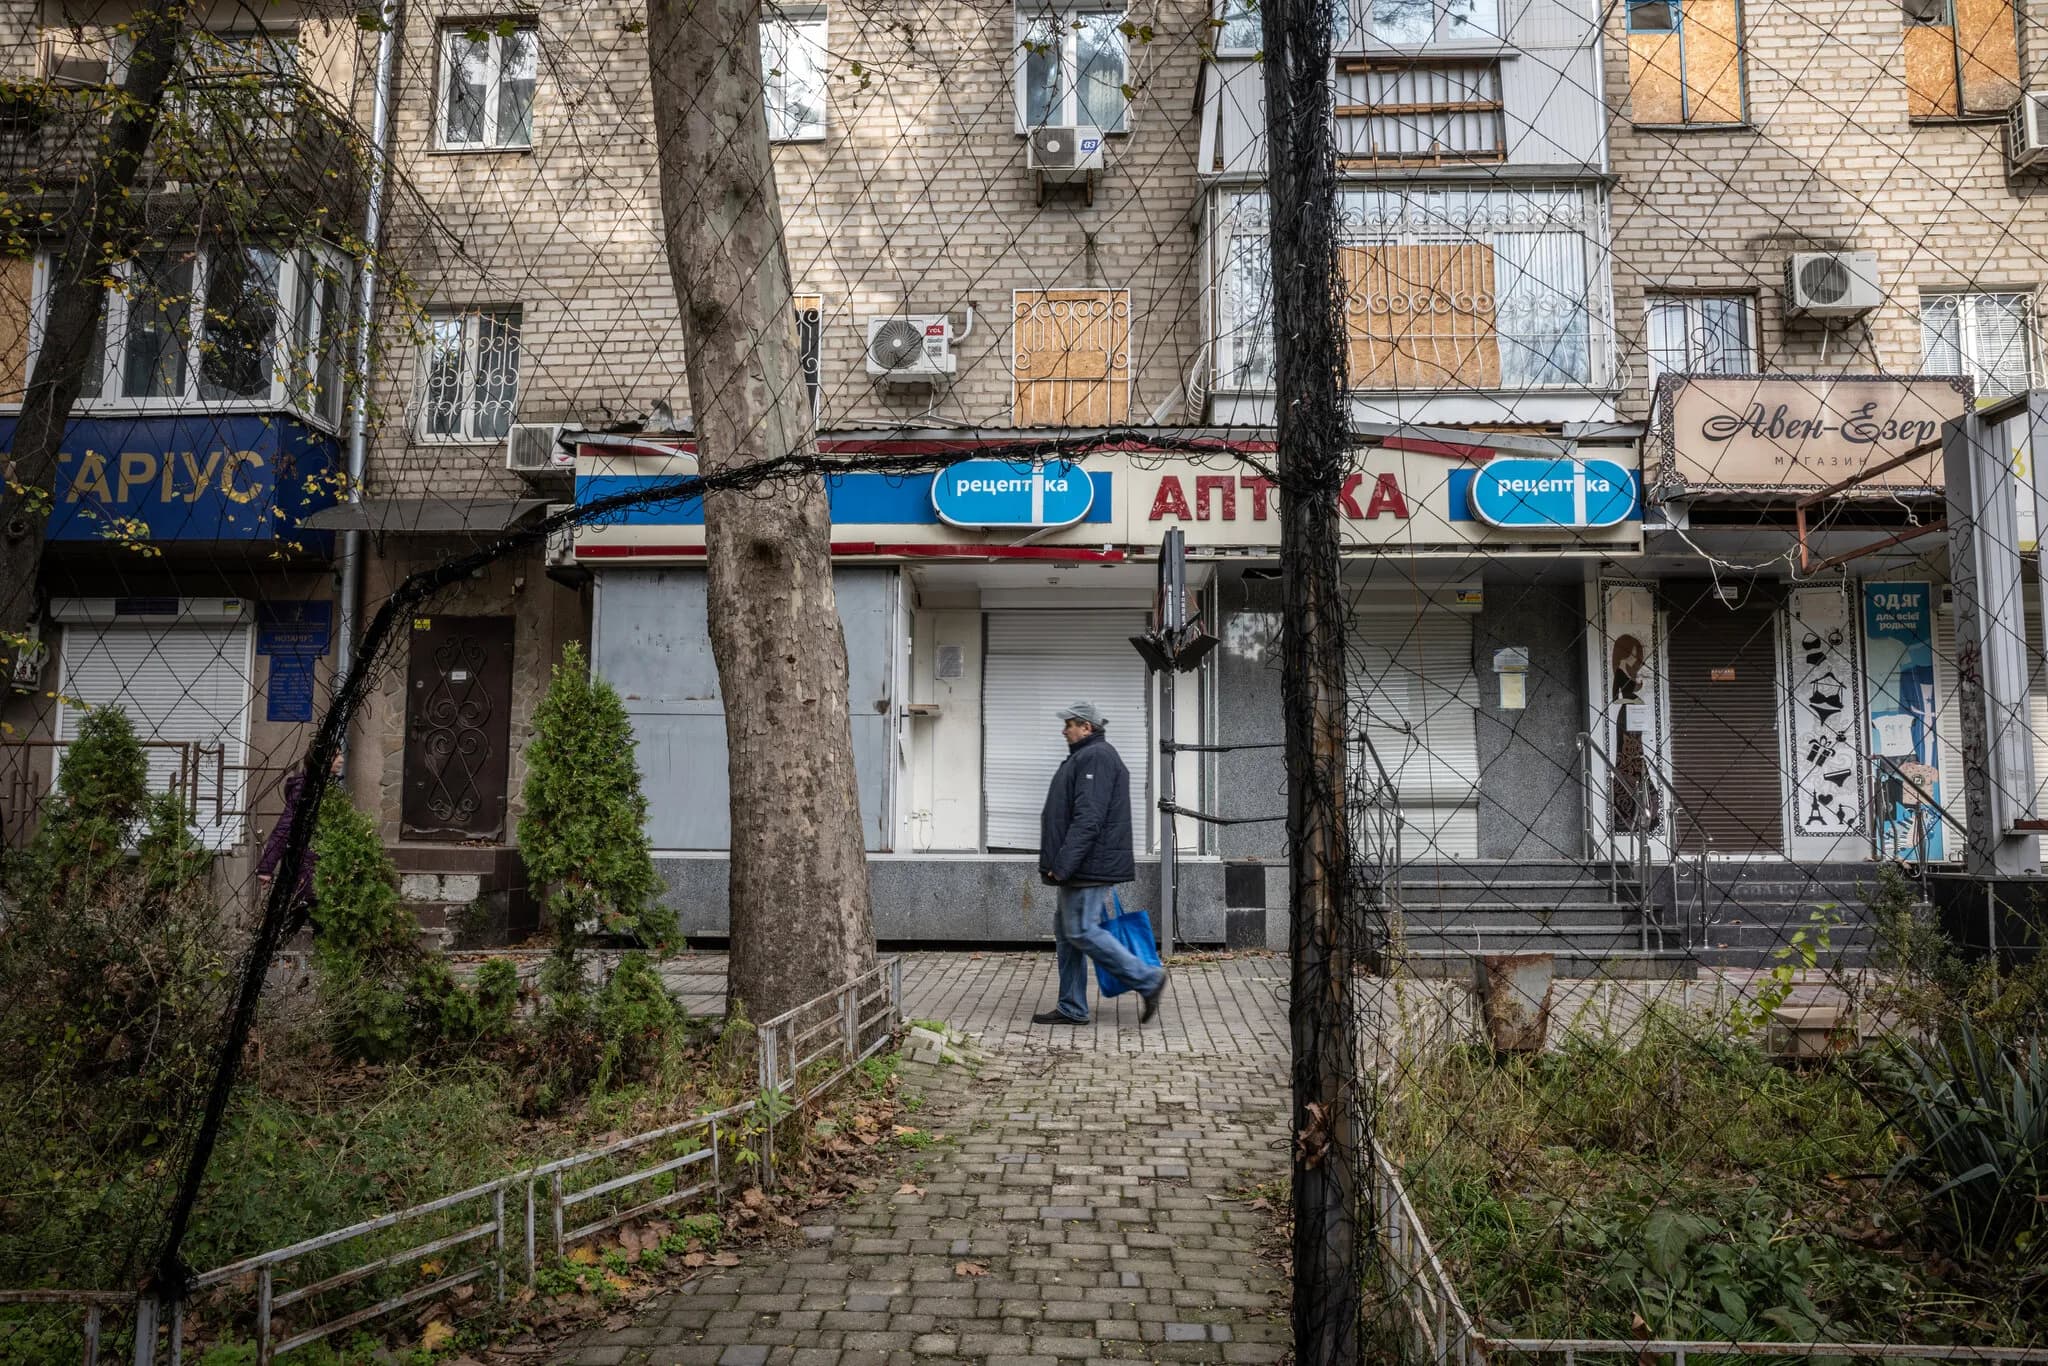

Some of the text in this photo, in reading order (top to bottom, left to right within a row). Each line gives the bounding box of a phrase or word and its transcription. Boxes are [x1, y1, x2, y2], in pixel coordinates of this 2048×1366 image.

[1701, 402, 1936, 447] Авен-Езер
[1774, 456, 1868, 466] МАГАЗИН
[1148, 473, 1410, 521] АПТКА
[1873, 593, 1921, 610] ОДЯГ
